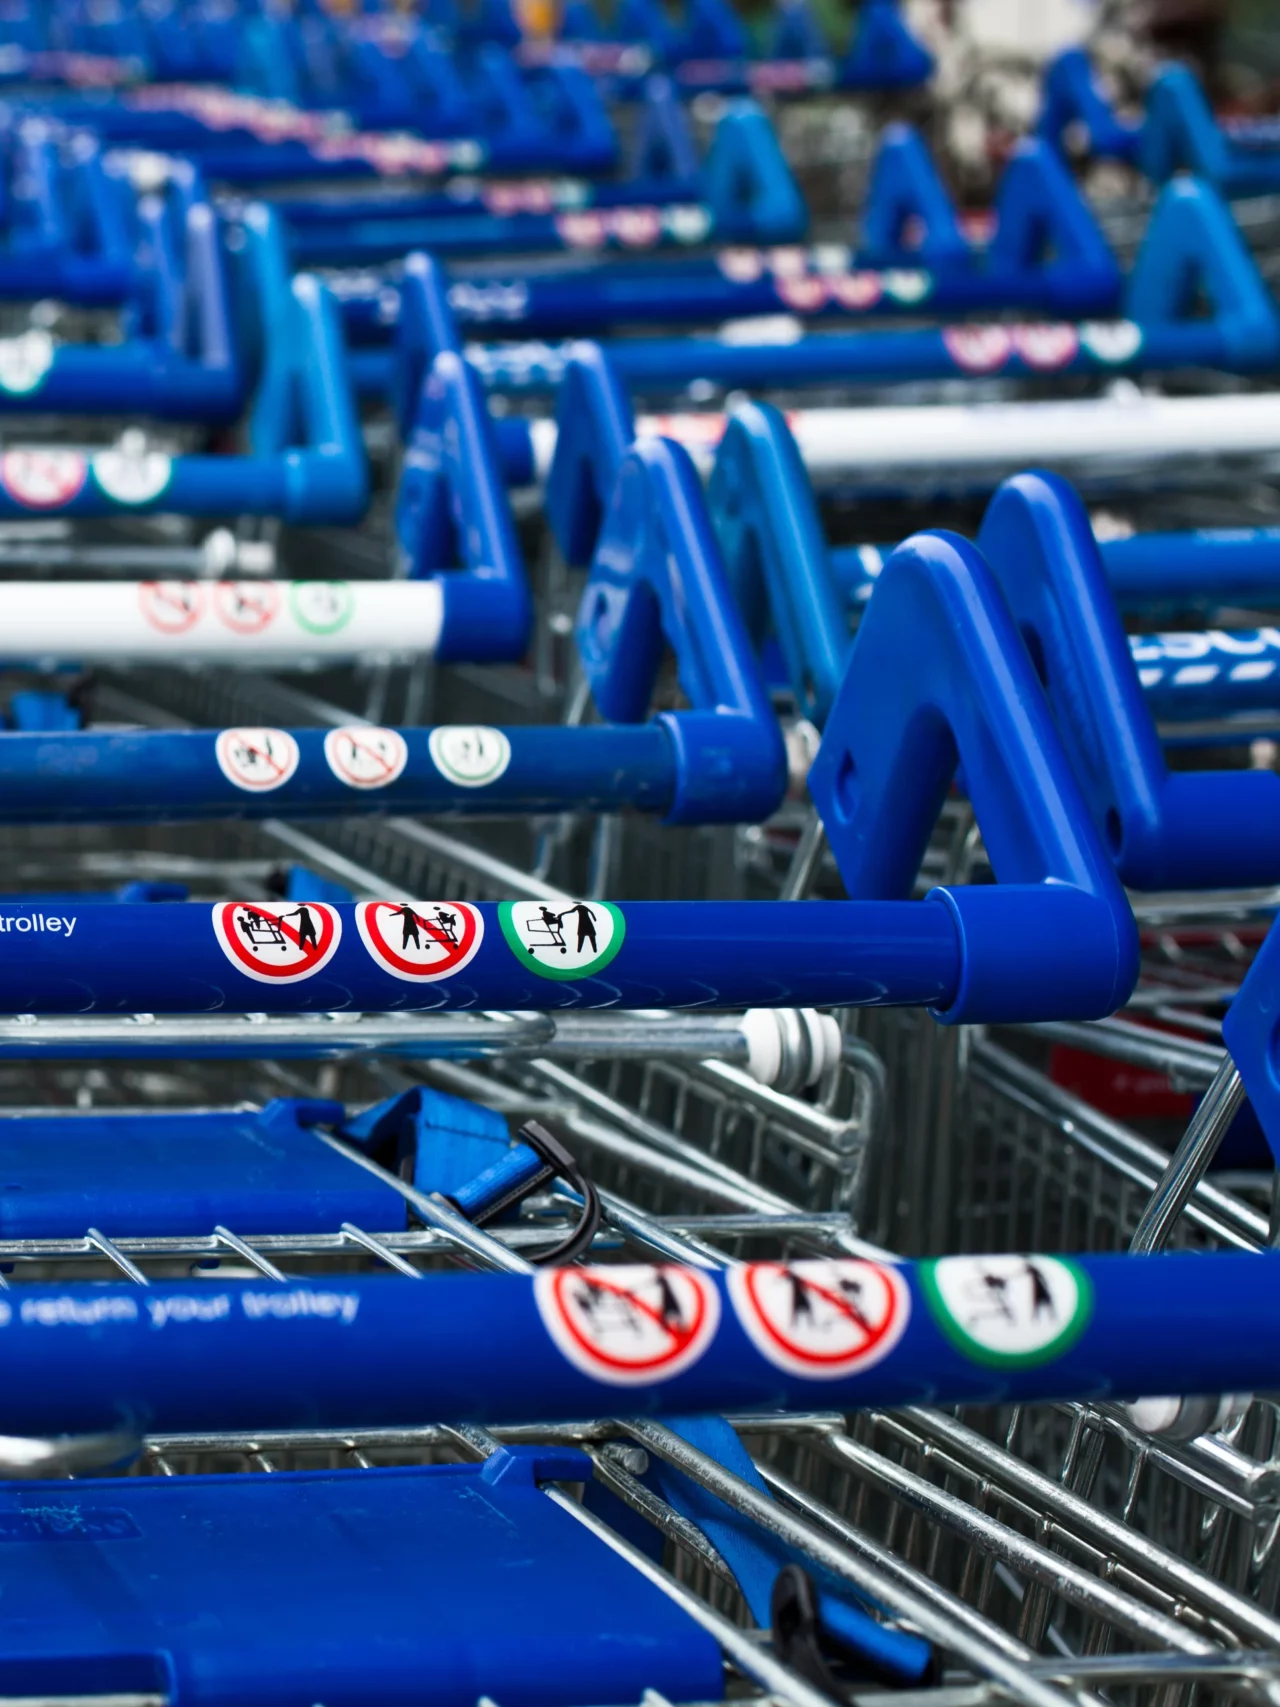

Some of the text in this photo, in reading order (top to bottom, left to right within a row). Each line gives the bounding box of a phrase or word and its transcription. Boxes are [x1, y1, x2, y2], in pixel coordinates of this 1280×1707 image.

[22, 1296, 138, 1325] return
[147, 1294, 230, 1329] your
[241, 1290, 360, 1325] trolley
